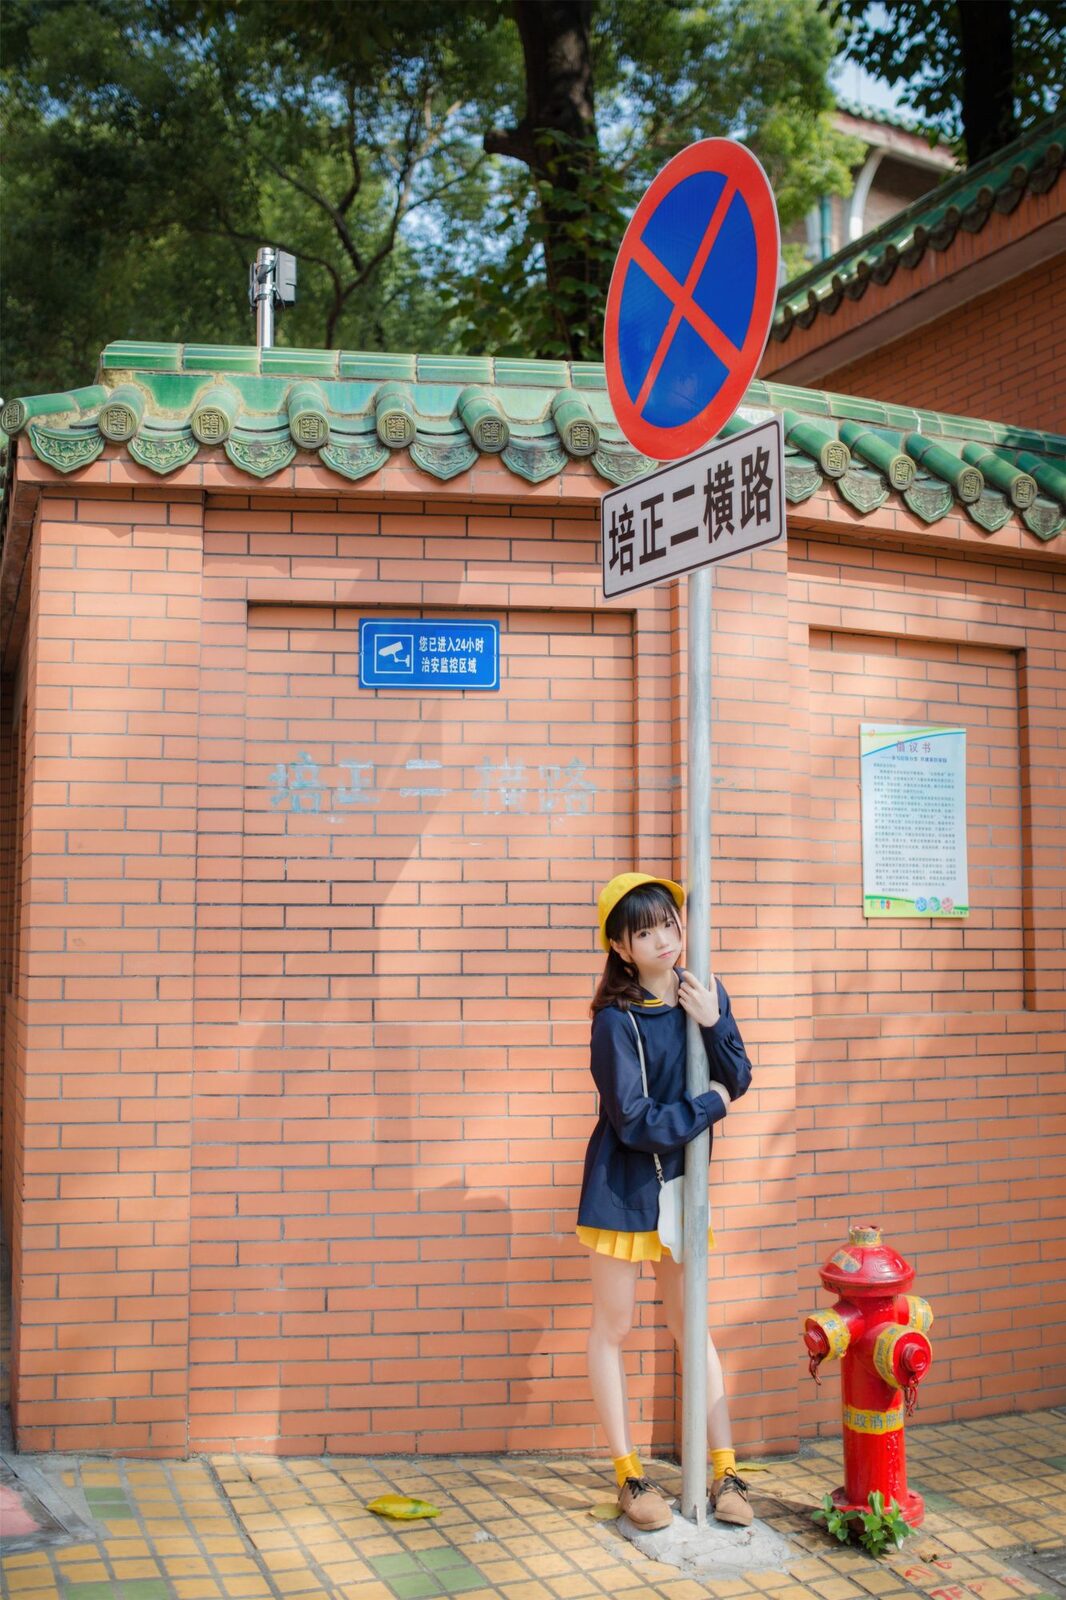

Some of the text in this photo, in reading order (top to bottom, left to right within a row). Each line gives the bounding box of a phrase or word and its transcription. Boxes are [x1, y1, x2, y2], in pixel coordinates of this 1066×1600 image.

[609, 446, 773, 576] 培正二横路
[419, 636, 485, 653] 您已进入24小时
[421, 657, 477, 673] 治安监控区域
[268, 751, 598, 816] 培正二横路
